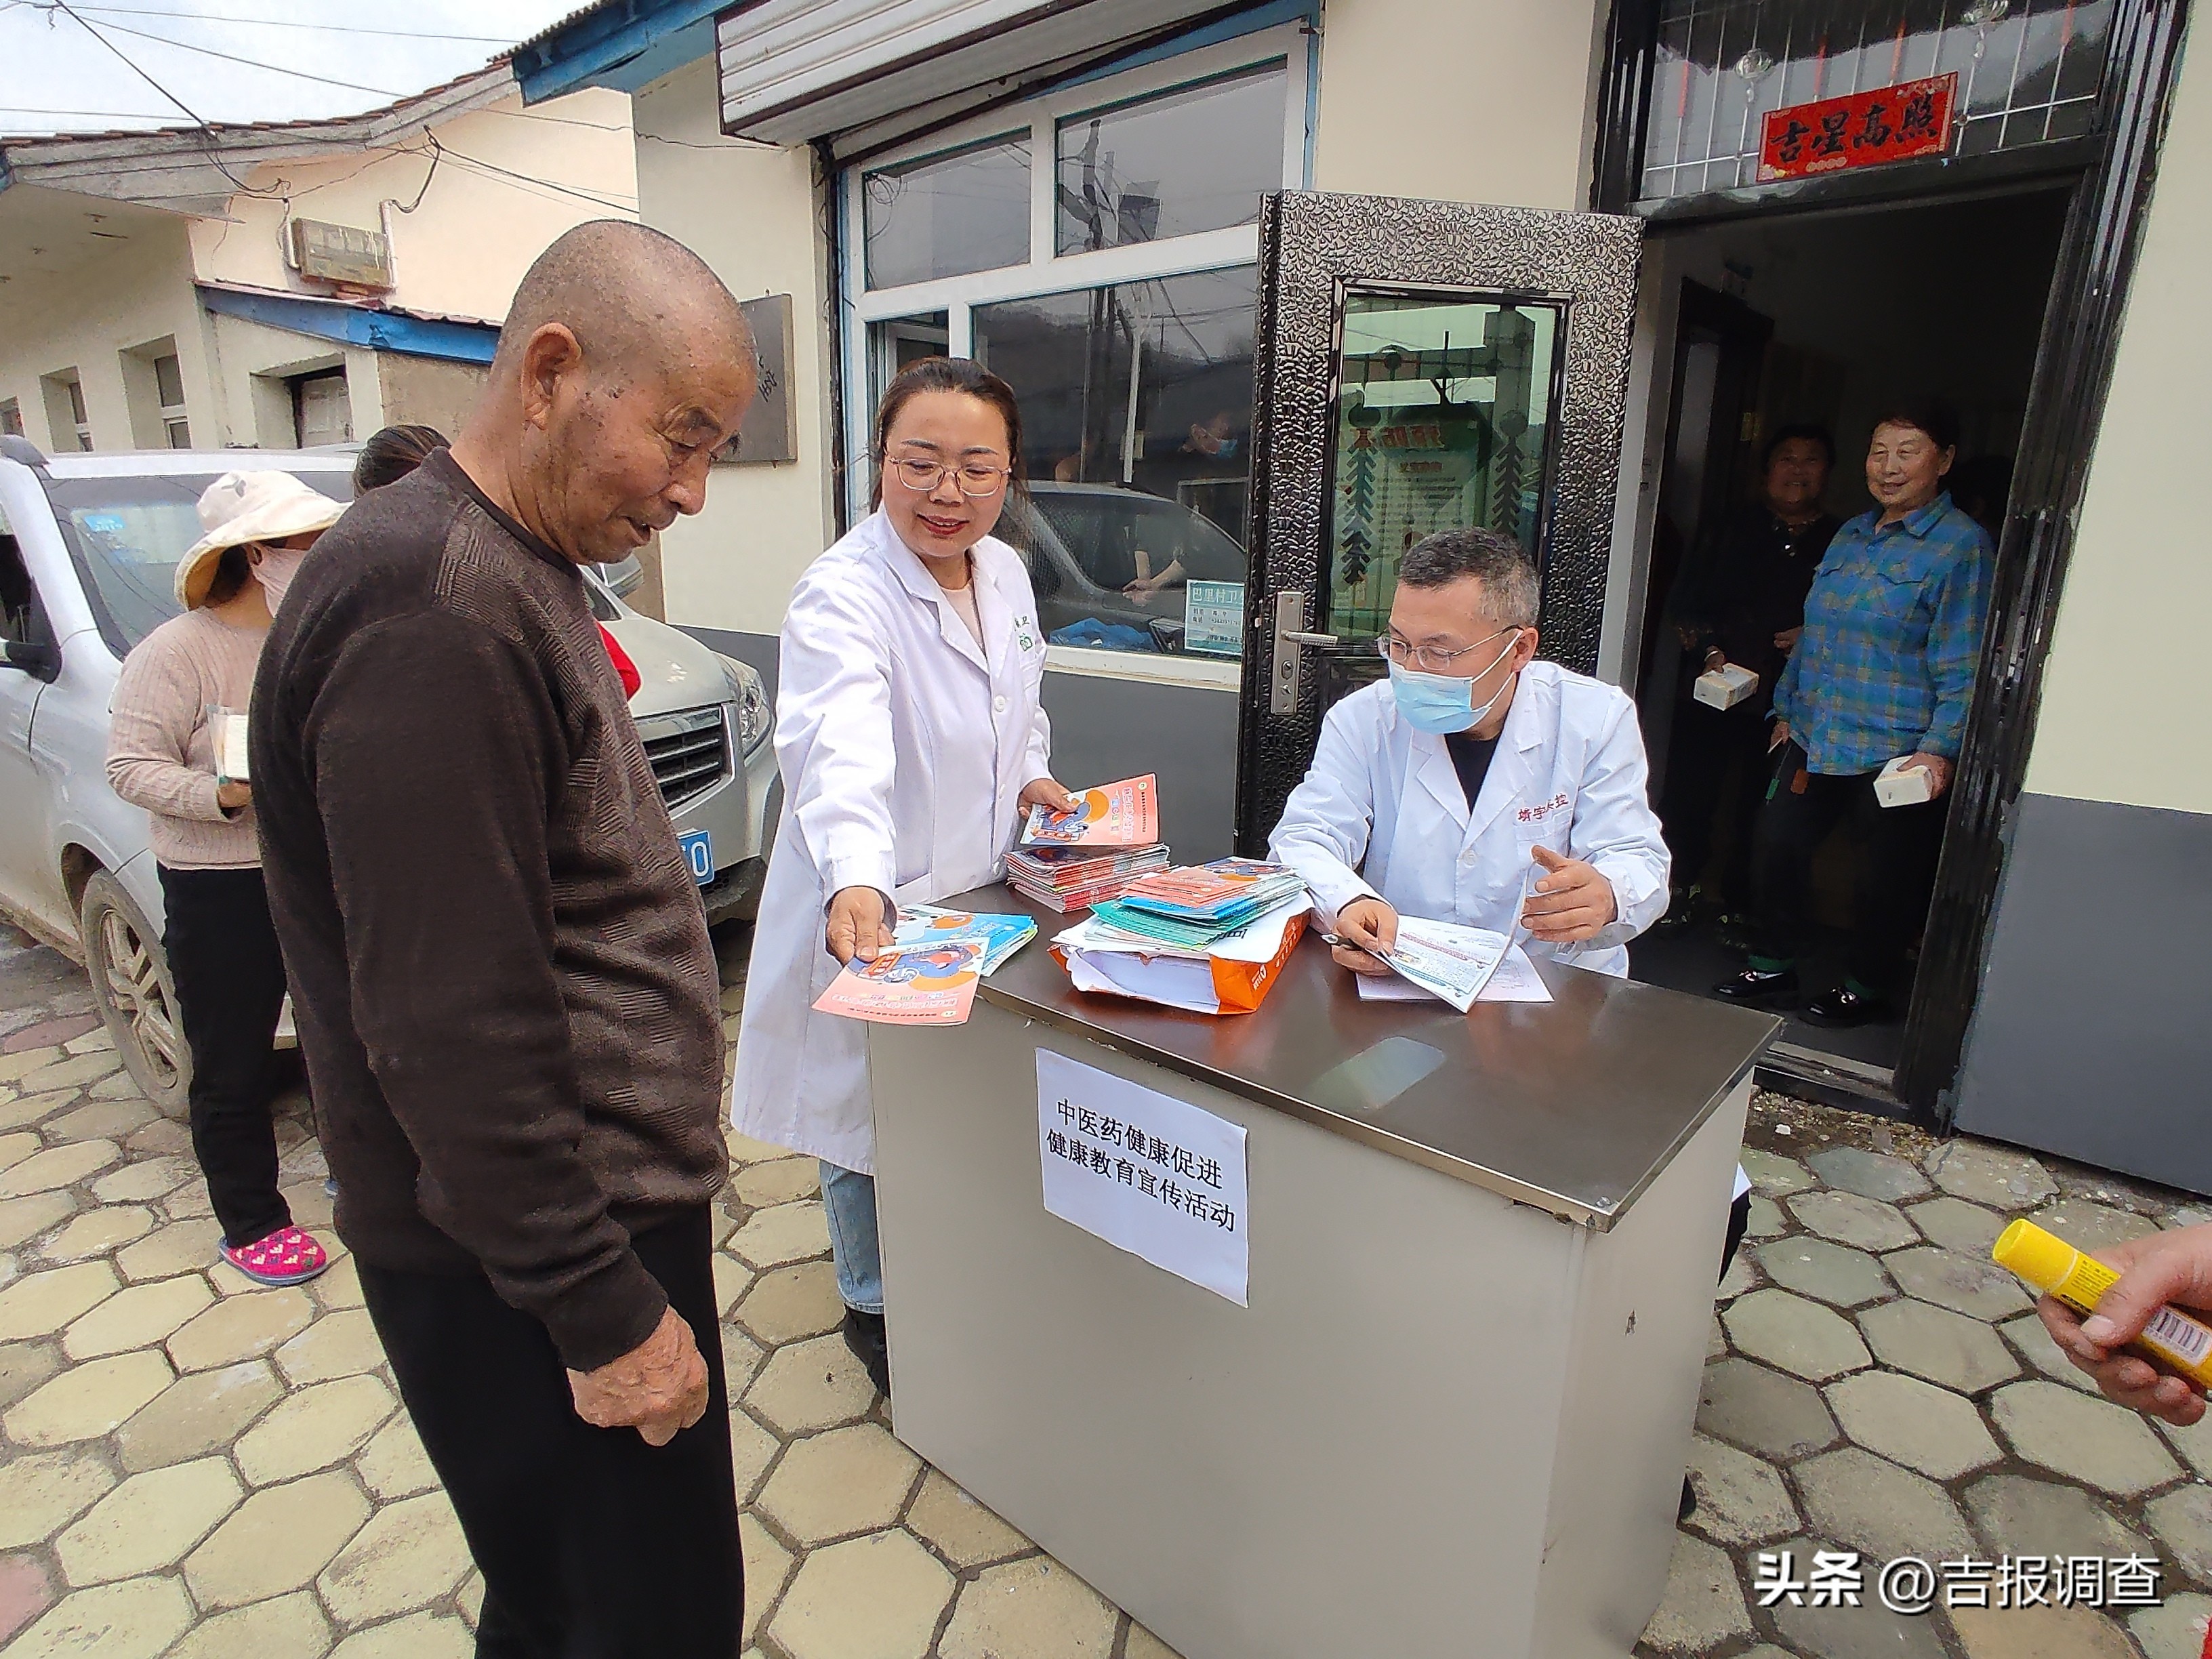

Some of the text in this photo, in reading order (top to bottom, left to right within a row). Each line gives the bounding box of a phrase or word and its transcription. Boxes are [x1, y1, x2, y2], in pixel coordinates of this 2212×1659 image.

[1769, 92, 1938, 163] 吉星高照
[1046, 1128, 1235, 1232] 健康教育宣传活动
[1057, 1098, 1223, 1190] 中医药健康促进
